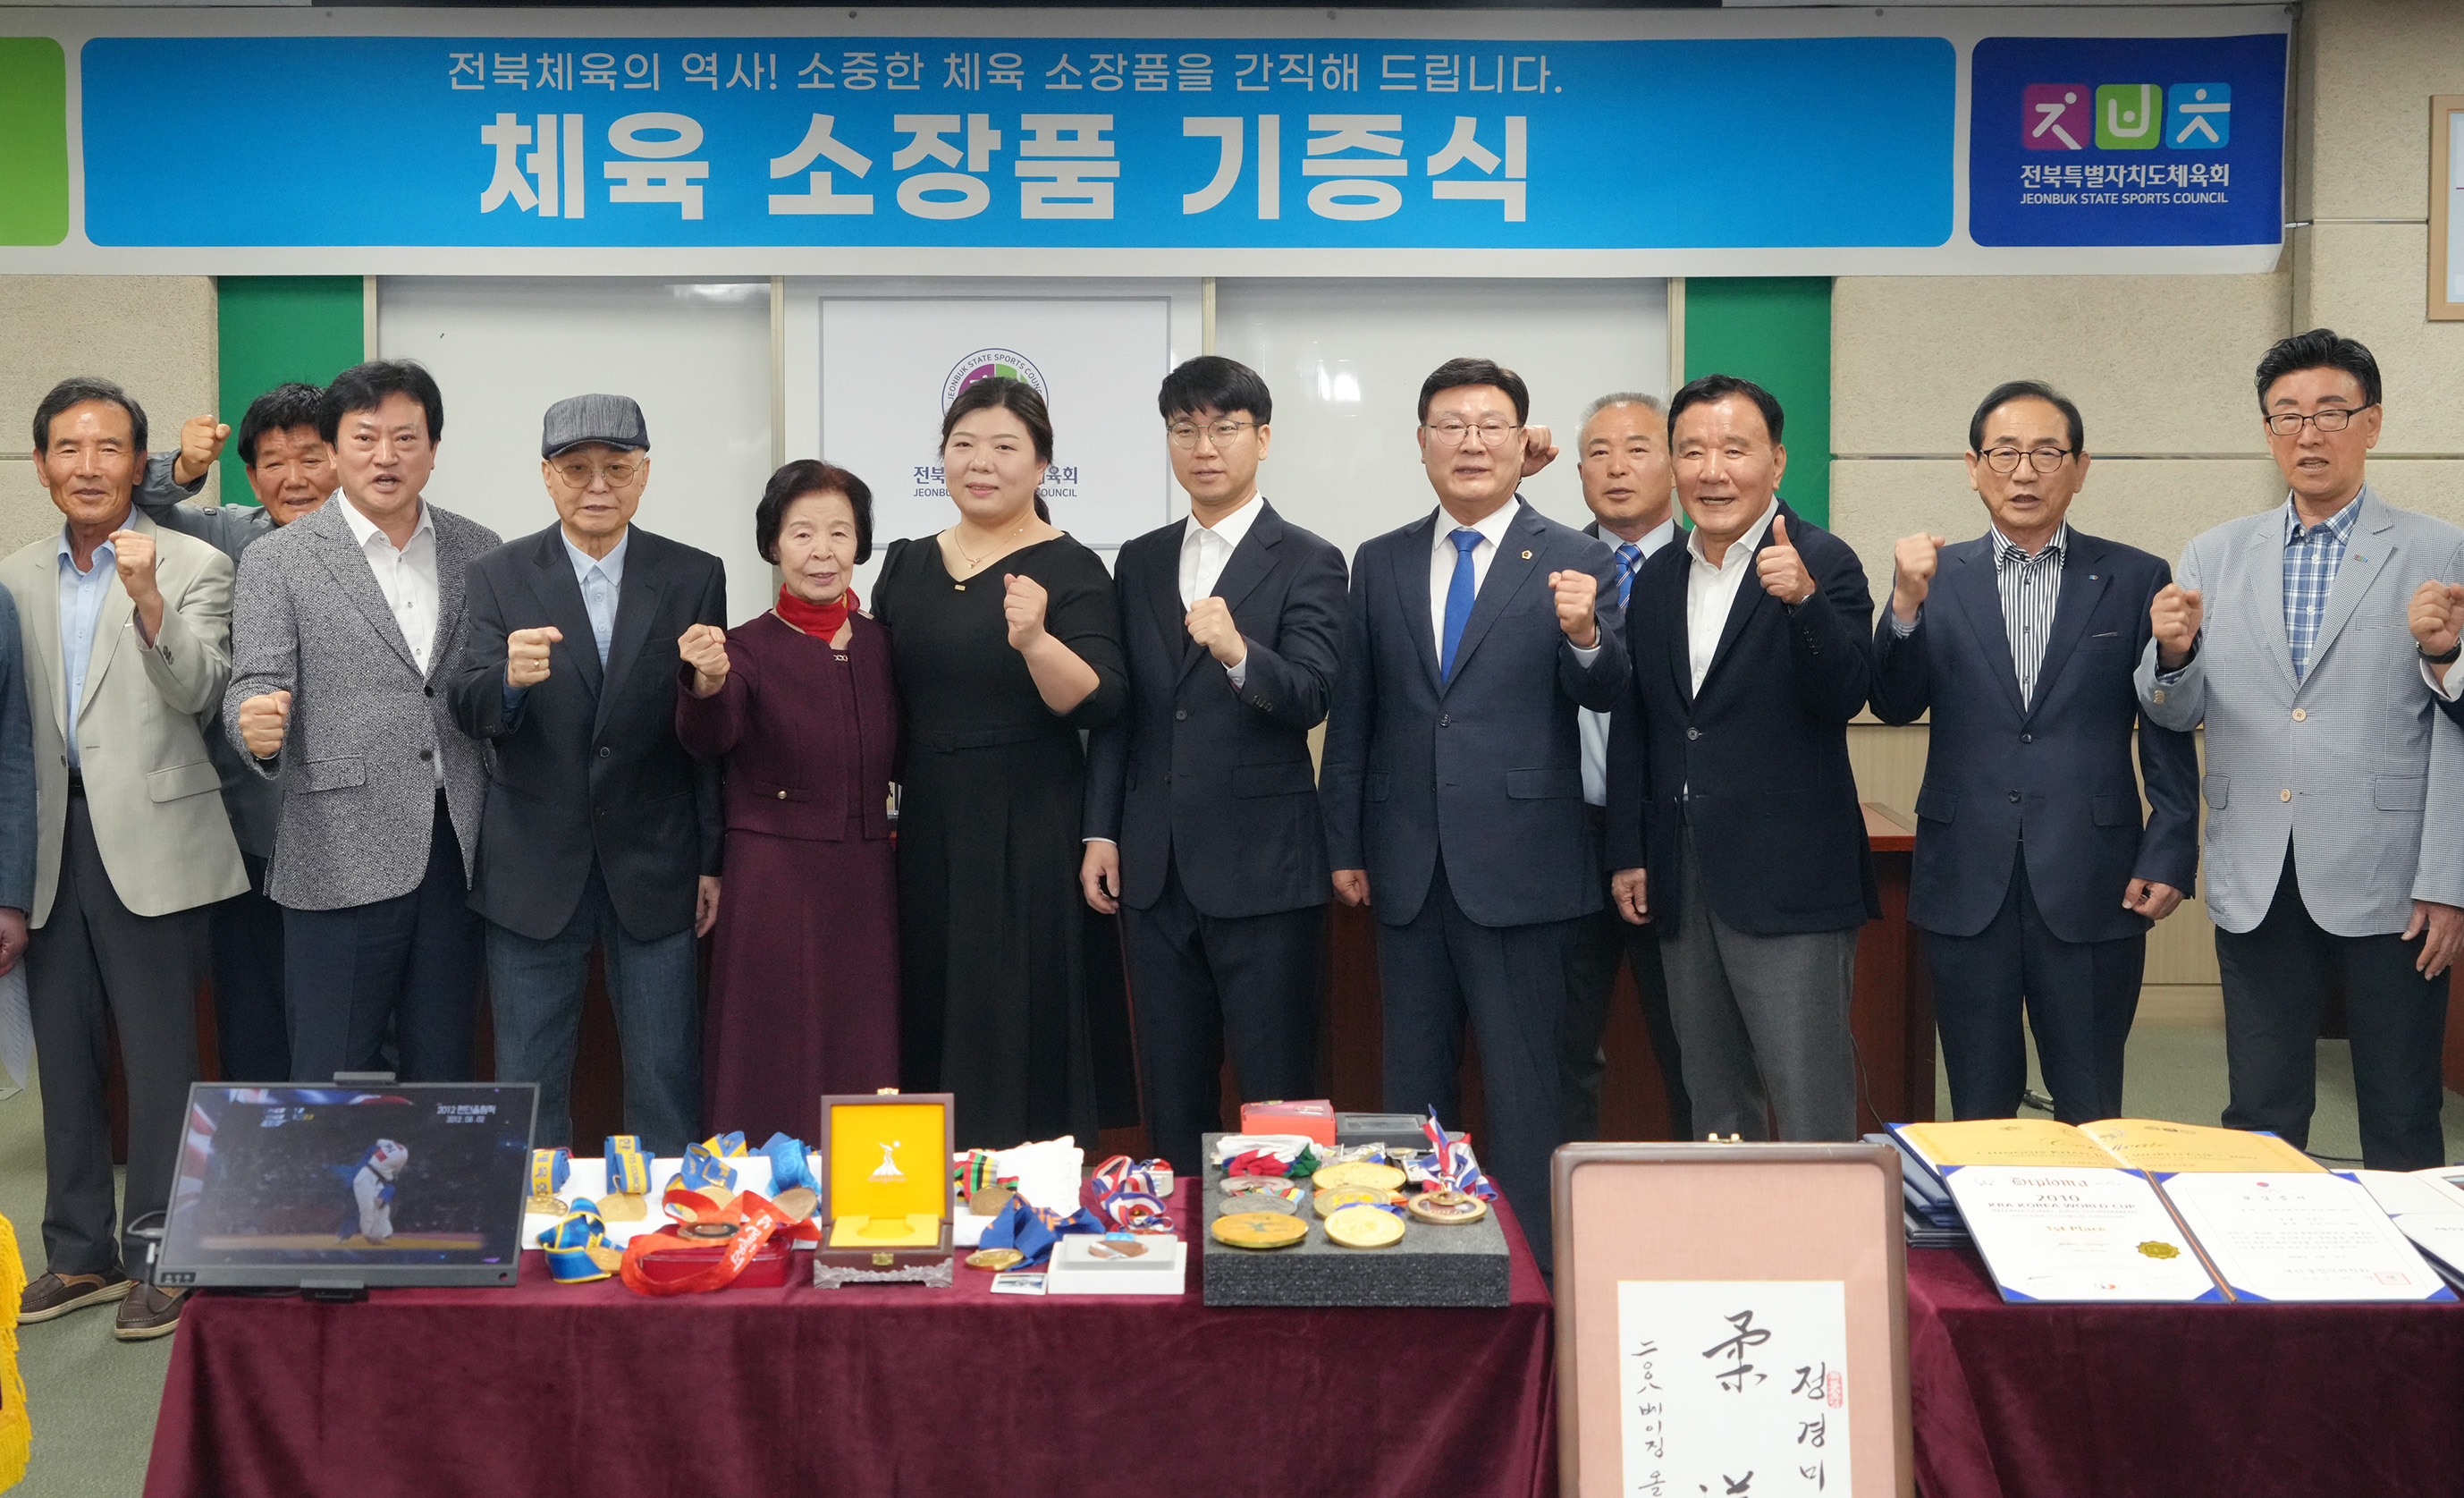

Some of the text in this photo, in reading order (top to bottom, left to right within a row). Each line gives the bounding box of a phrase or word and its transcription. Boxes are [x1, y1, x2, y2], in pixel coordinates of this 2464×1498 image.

[448, 52, 1564, 94] 전북체육의 역사! 소중한 체육 소장품을 간직해 드립니다.
[480, 112, 1528, 223] 체육 소장품 기증식
[2021, 164, 2230, 189] 전북특별자치도체육회
[2021, 192, 2229, 206] JEONBUK STATE SPORTS COUNCIL
[947, 353, 1042, 402] JEONBUK STATE SPORTS COUNC
[913, 487, 1077, 497] JEONBU OUNCIL
[2010, 1177, 2089, 1188] Diploma
[2035, 1194, 2080, 1202] 2010
[1638, 1401, 1665, 1459] 베이징
[1791, 1362, 1826, 1493] 정경미
